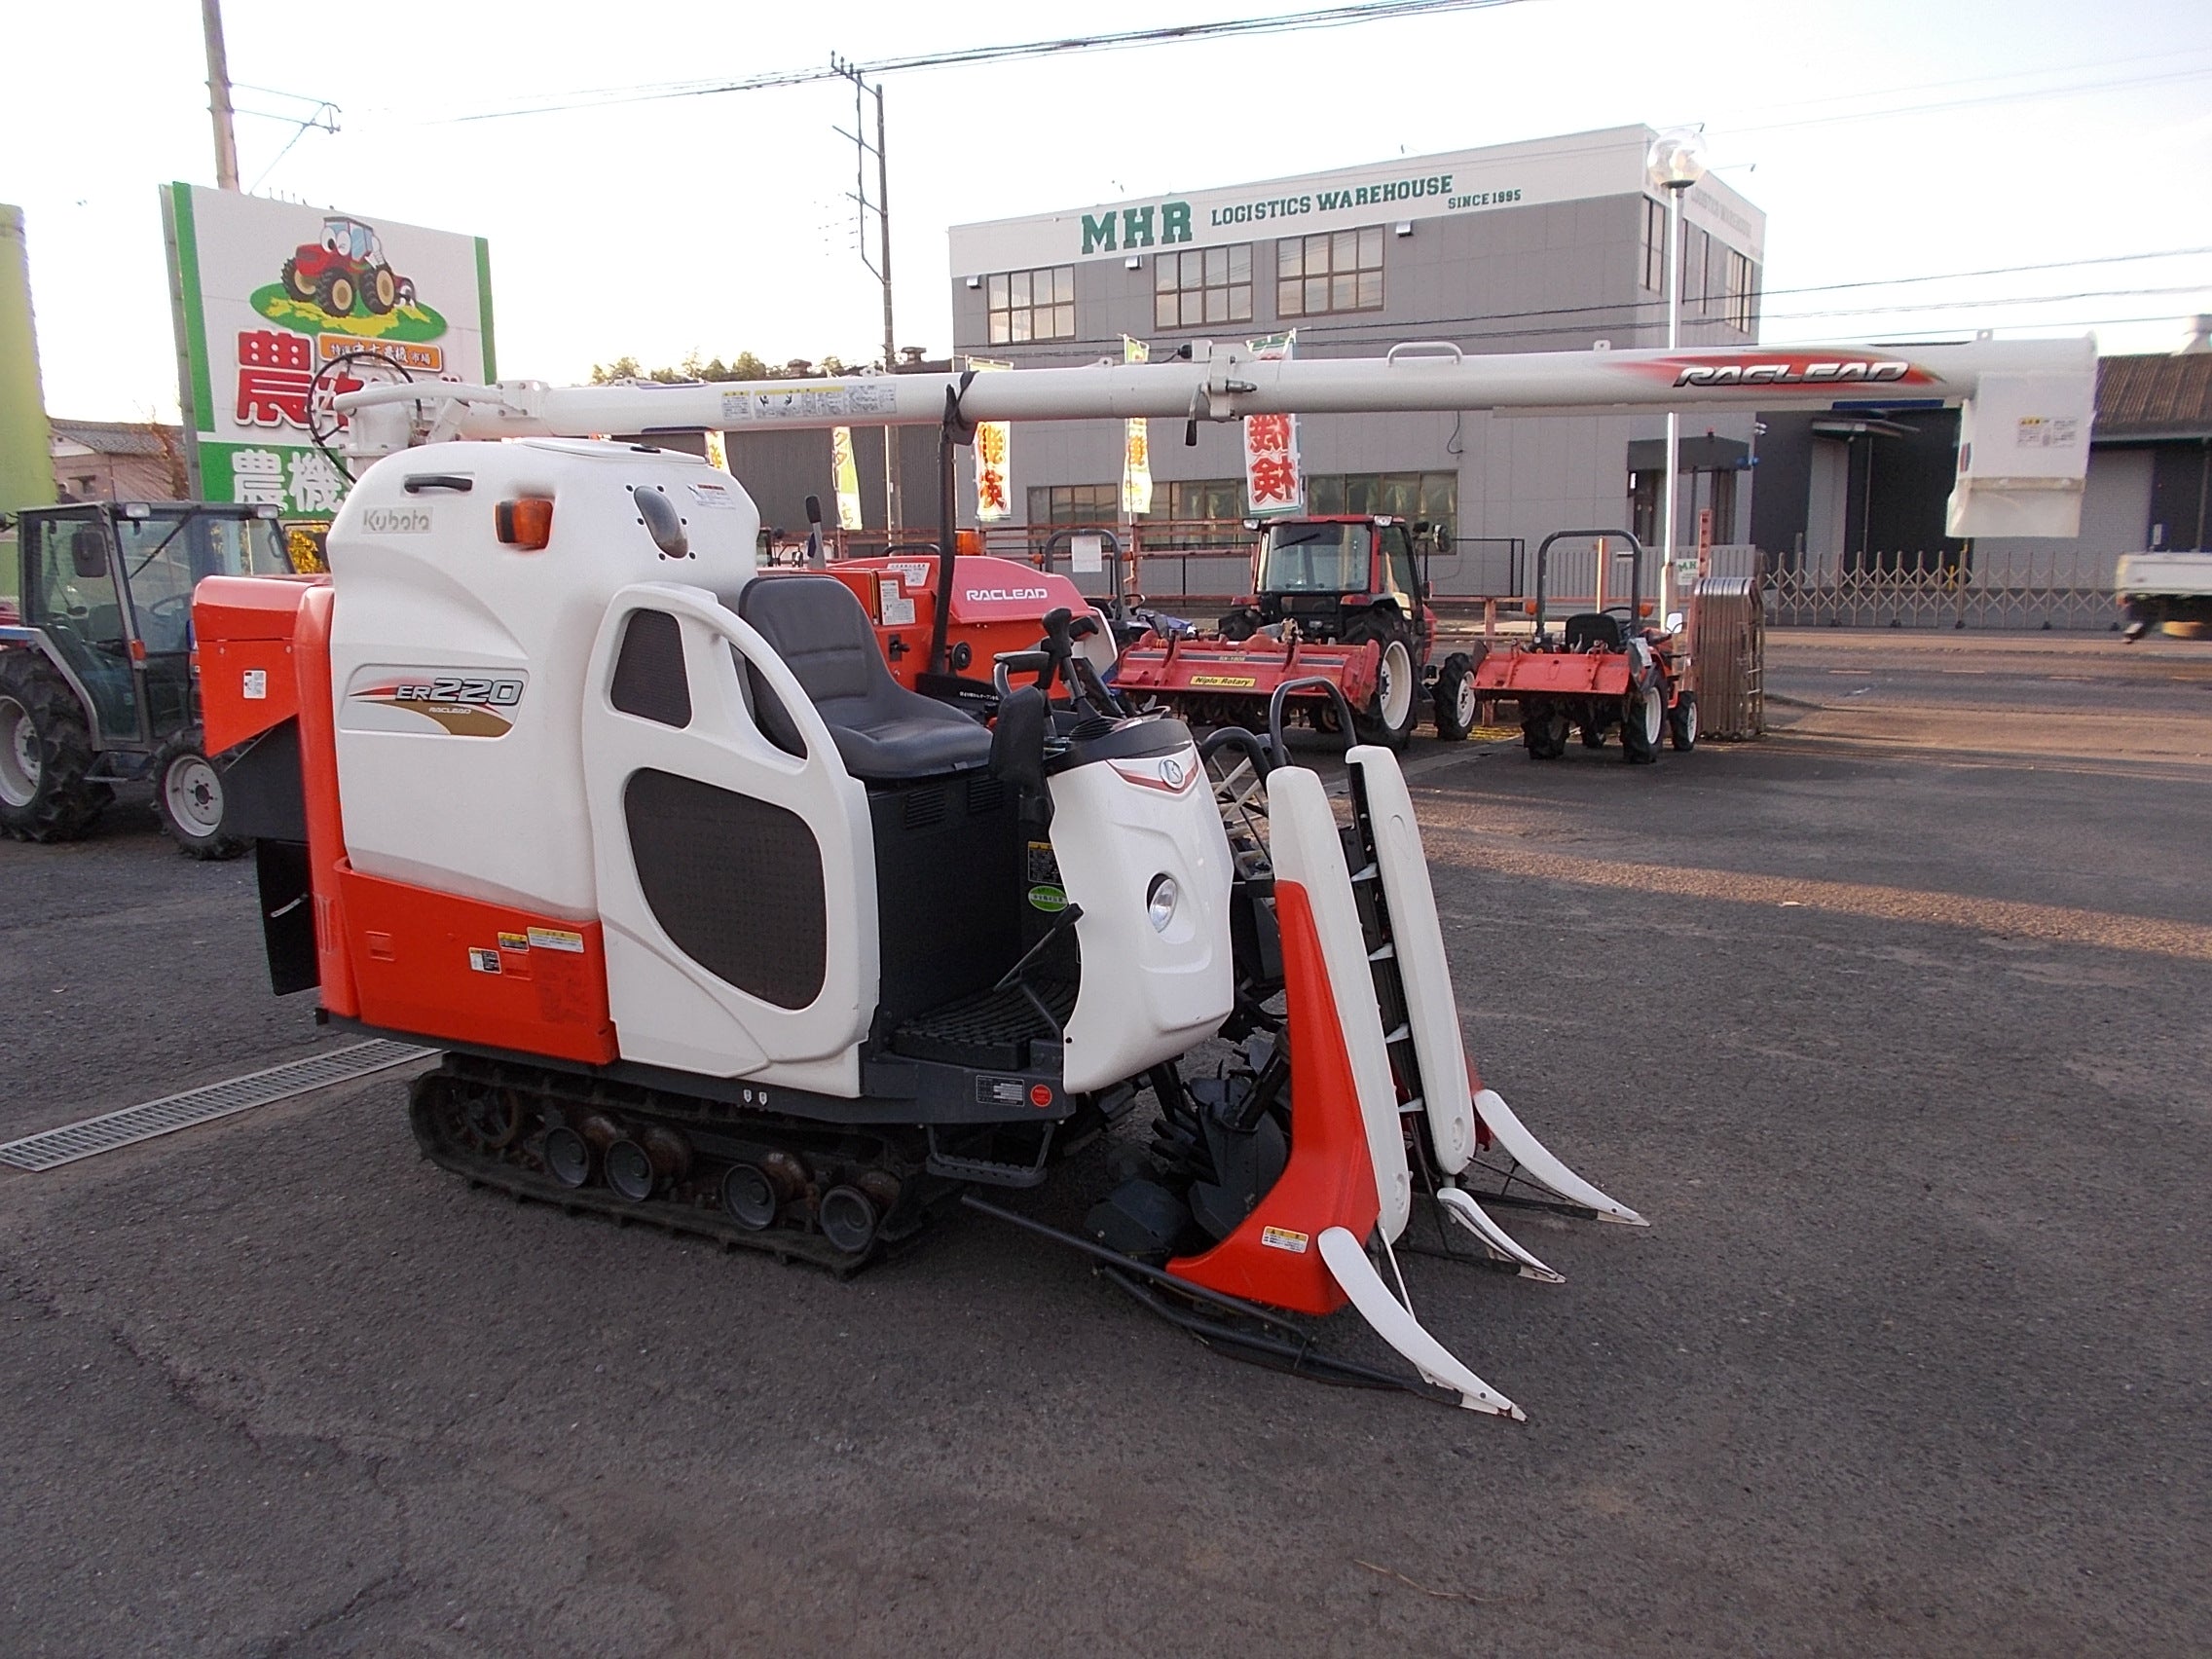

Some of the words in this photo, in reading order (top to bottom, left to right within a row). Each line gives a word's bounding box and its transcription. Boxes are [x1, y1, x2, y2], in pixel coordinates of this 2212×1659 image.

[1448, 193, 1490, 209] SINCE
[1081, 201, 1193, 255] MHR
[1211, 195, 1311, 227] LOGISTICS
[1316, 174, 1453, 211] WAREHOUSE
[1672, 361, 1911, 387] RACLEAD
[363, 509, 429, 532] Kubota
[966, 588, 1049, 602] RACLEAD
[394, 678, 524, 706] ER220
[1195, 677, 1218, 685] Niplo
[1221, 678, 1251, 686] Rotary
